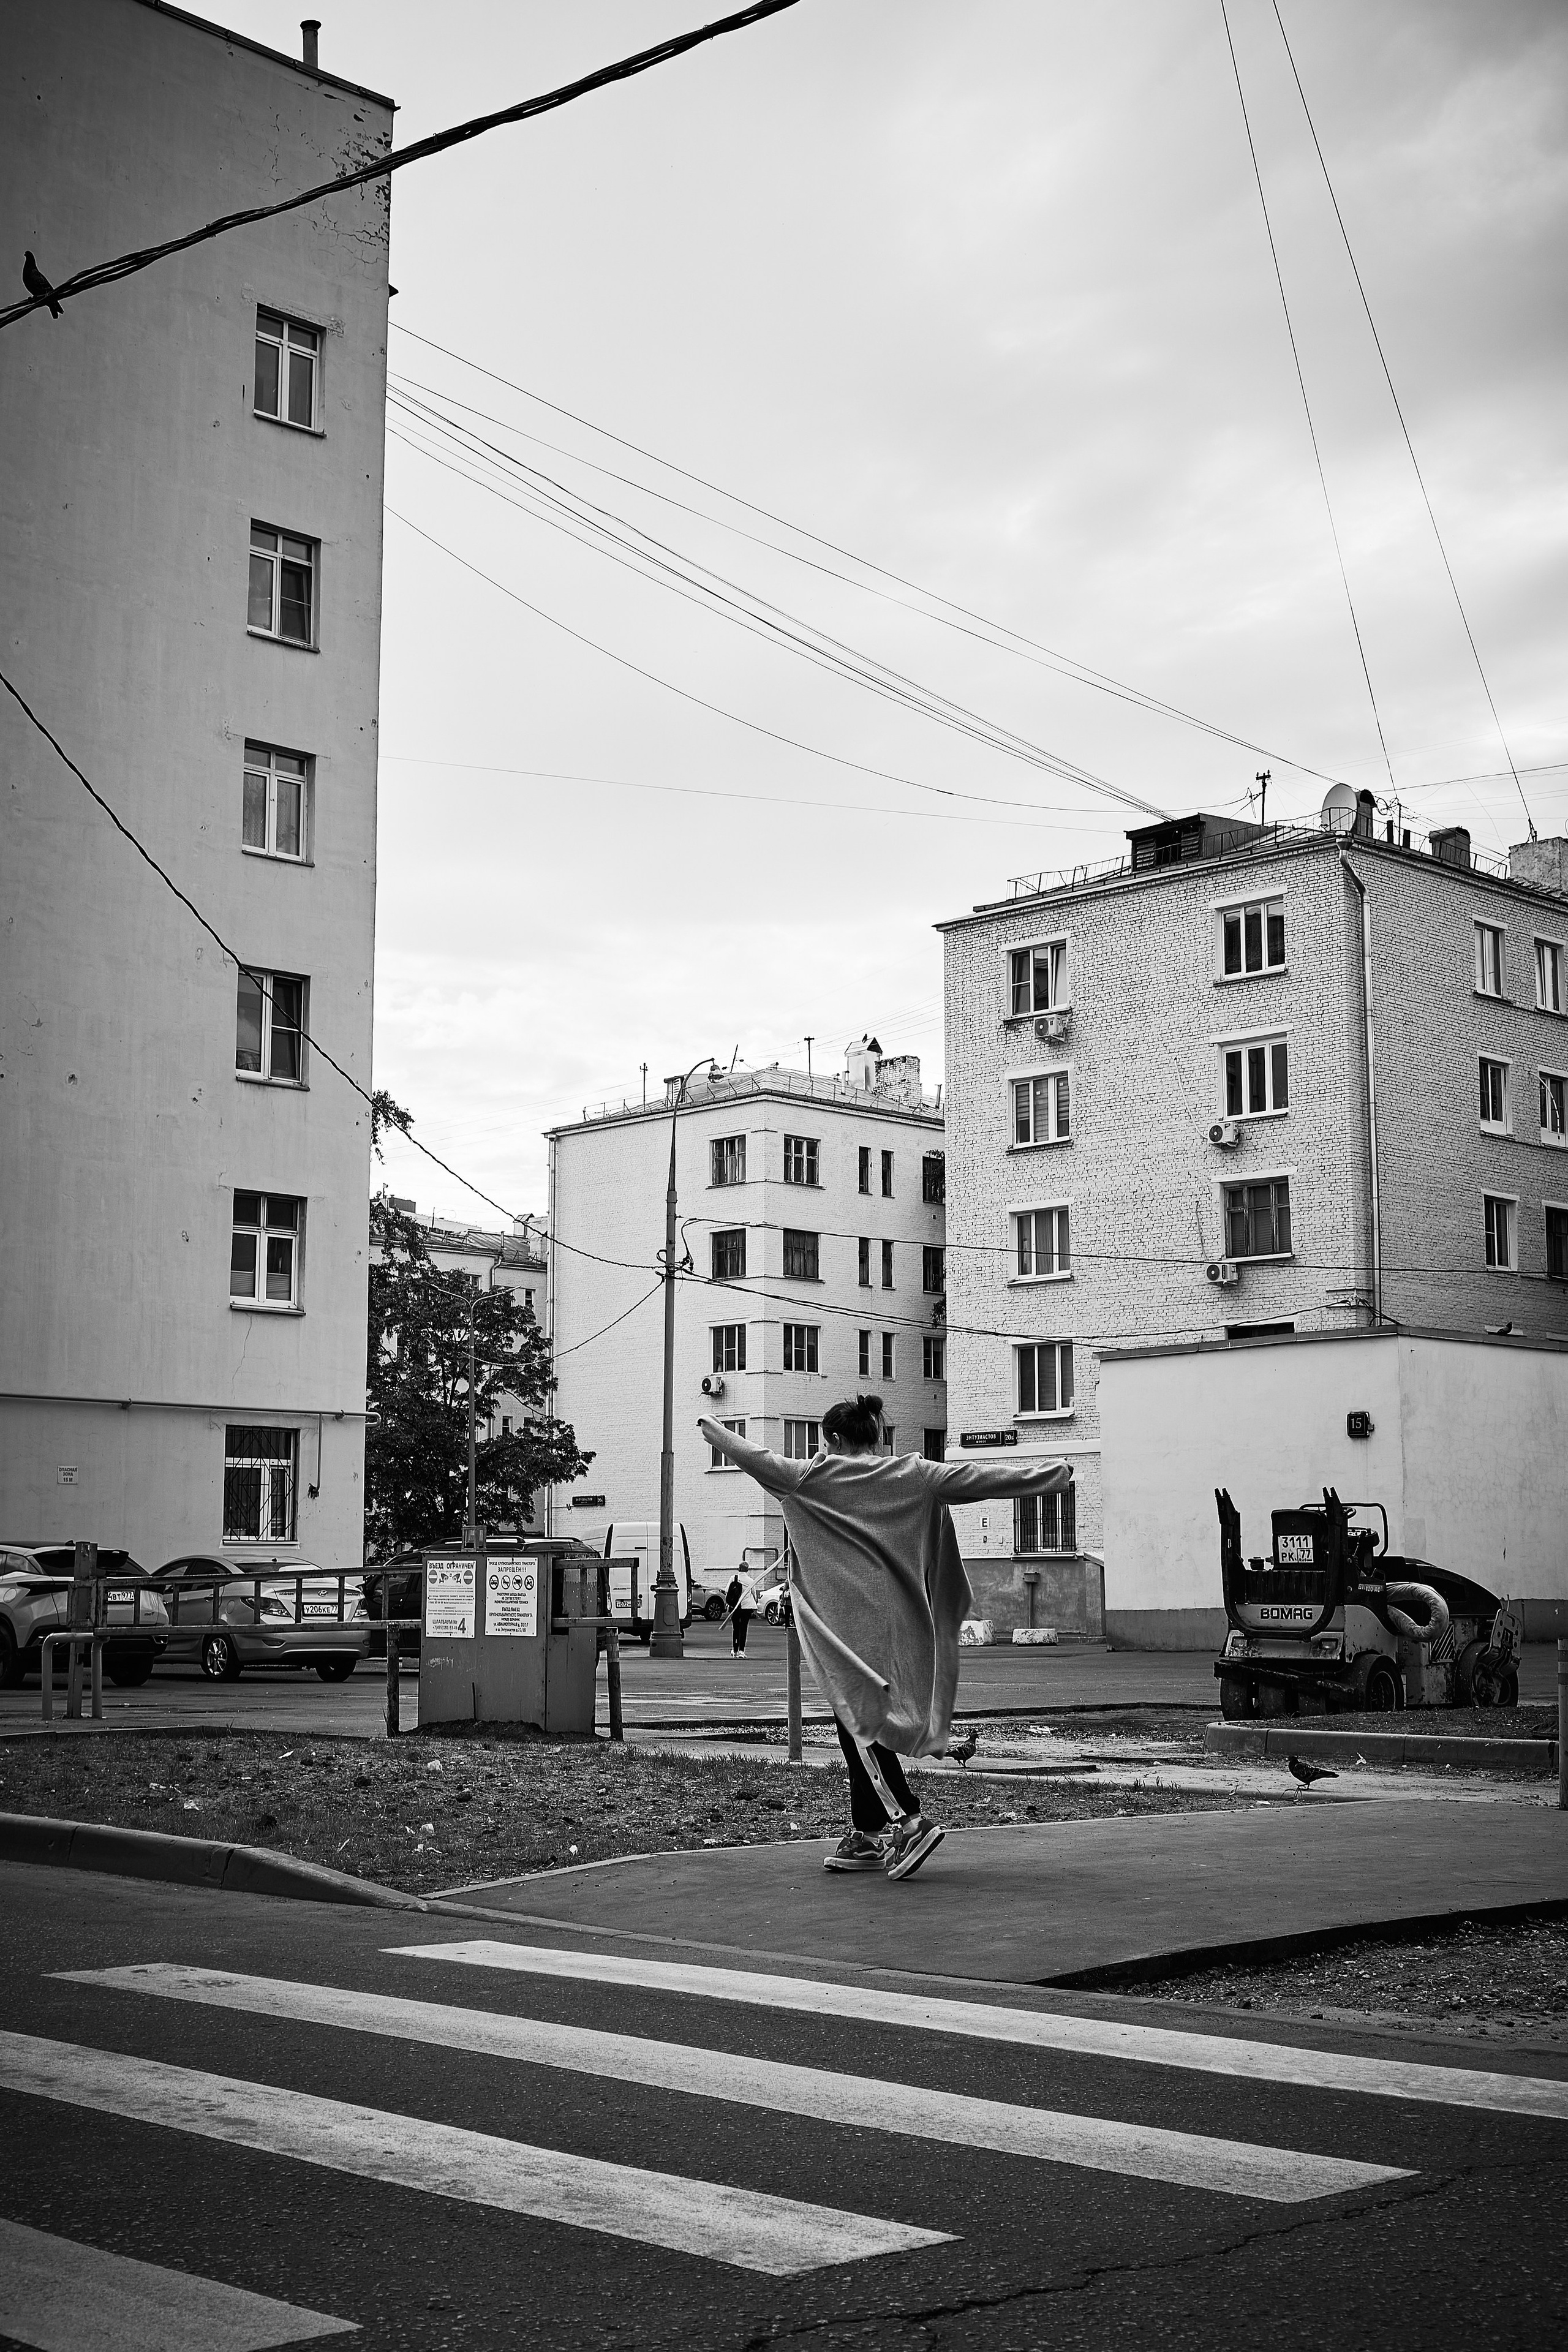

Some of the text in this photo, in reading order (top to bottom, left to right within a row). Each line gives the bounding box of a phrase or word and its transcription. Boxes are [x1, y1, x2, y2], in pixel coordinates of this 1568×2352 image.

[1351, 1417, 1362, 1429] 15
[1282, 1536, 1308, 1548] 3111
[1300, 1550, 1311, 1558] 77
[1261, 1607, 1313, 1619] BOMAG
[458, 1618, 466, 1634] 4
